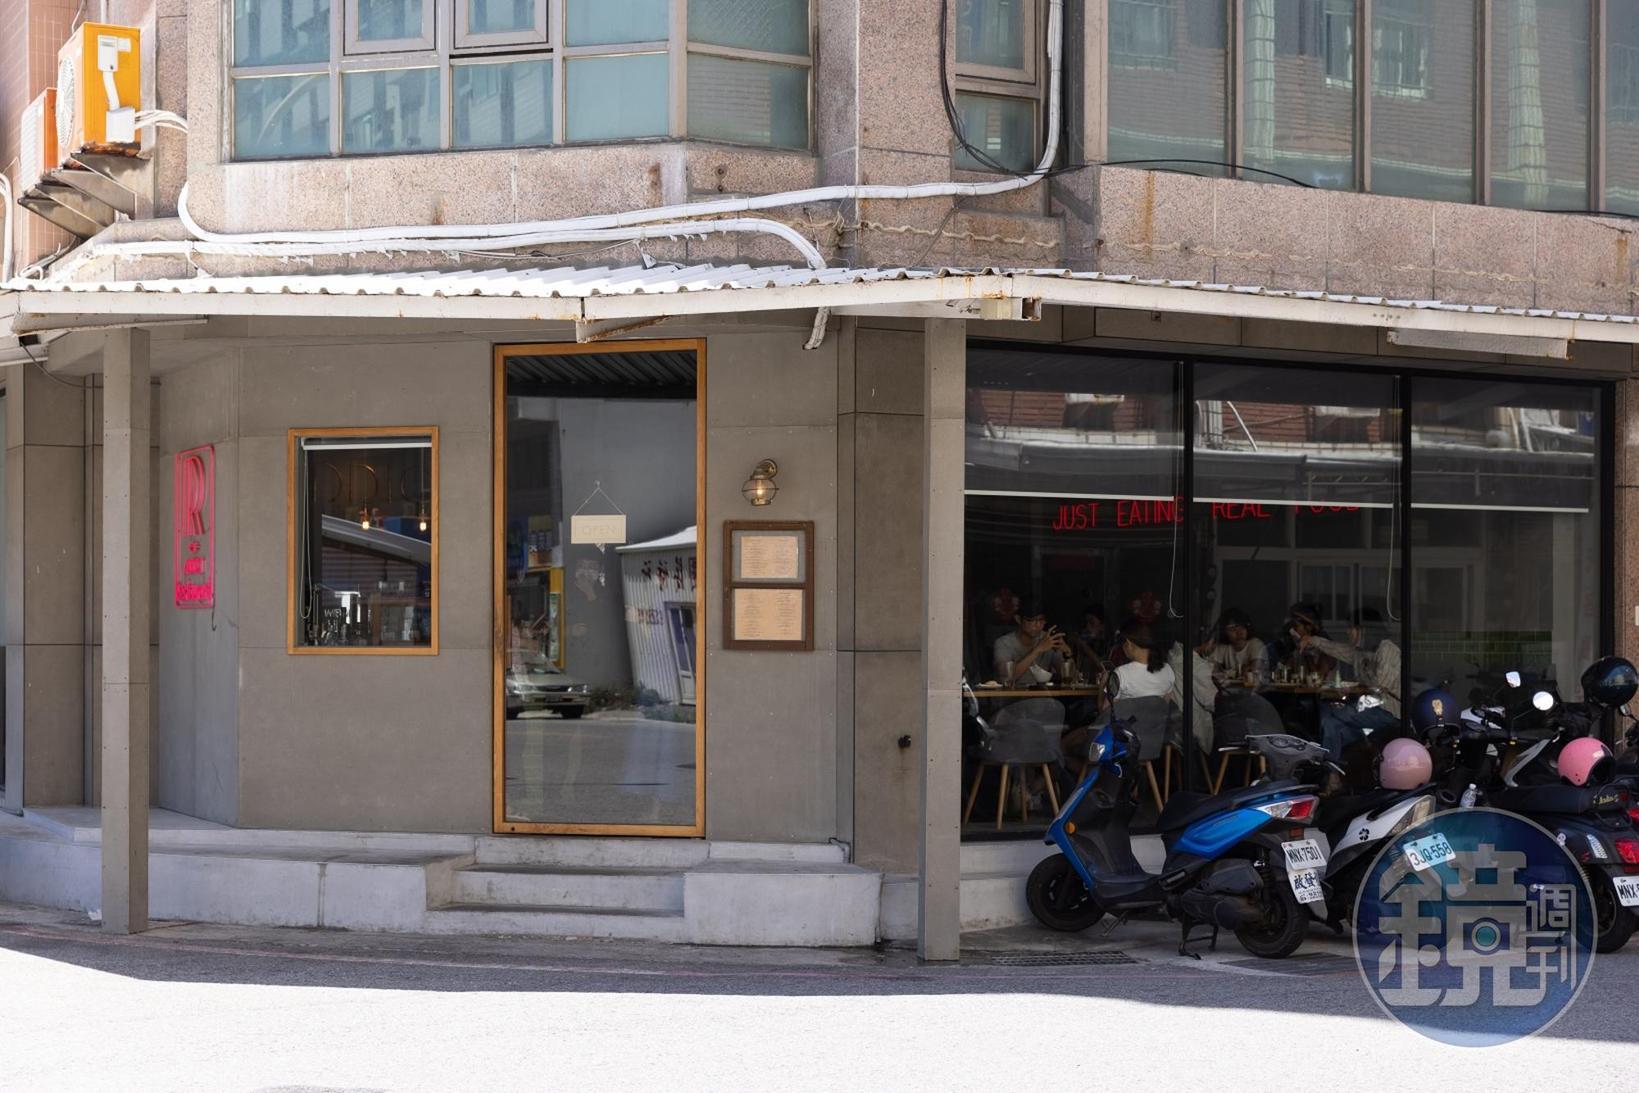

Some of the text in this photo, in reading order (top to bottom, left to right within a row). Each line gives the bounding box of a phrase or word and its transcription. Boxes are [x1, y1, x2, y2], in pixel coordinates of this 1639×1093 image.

[1052, 502, 1099, 531] JUST
[1116, 496, 1184, 528] EATING
[1212, 501, 1271, 520] REAL
[1410, 842, 1452, 866] 3JQ-558
